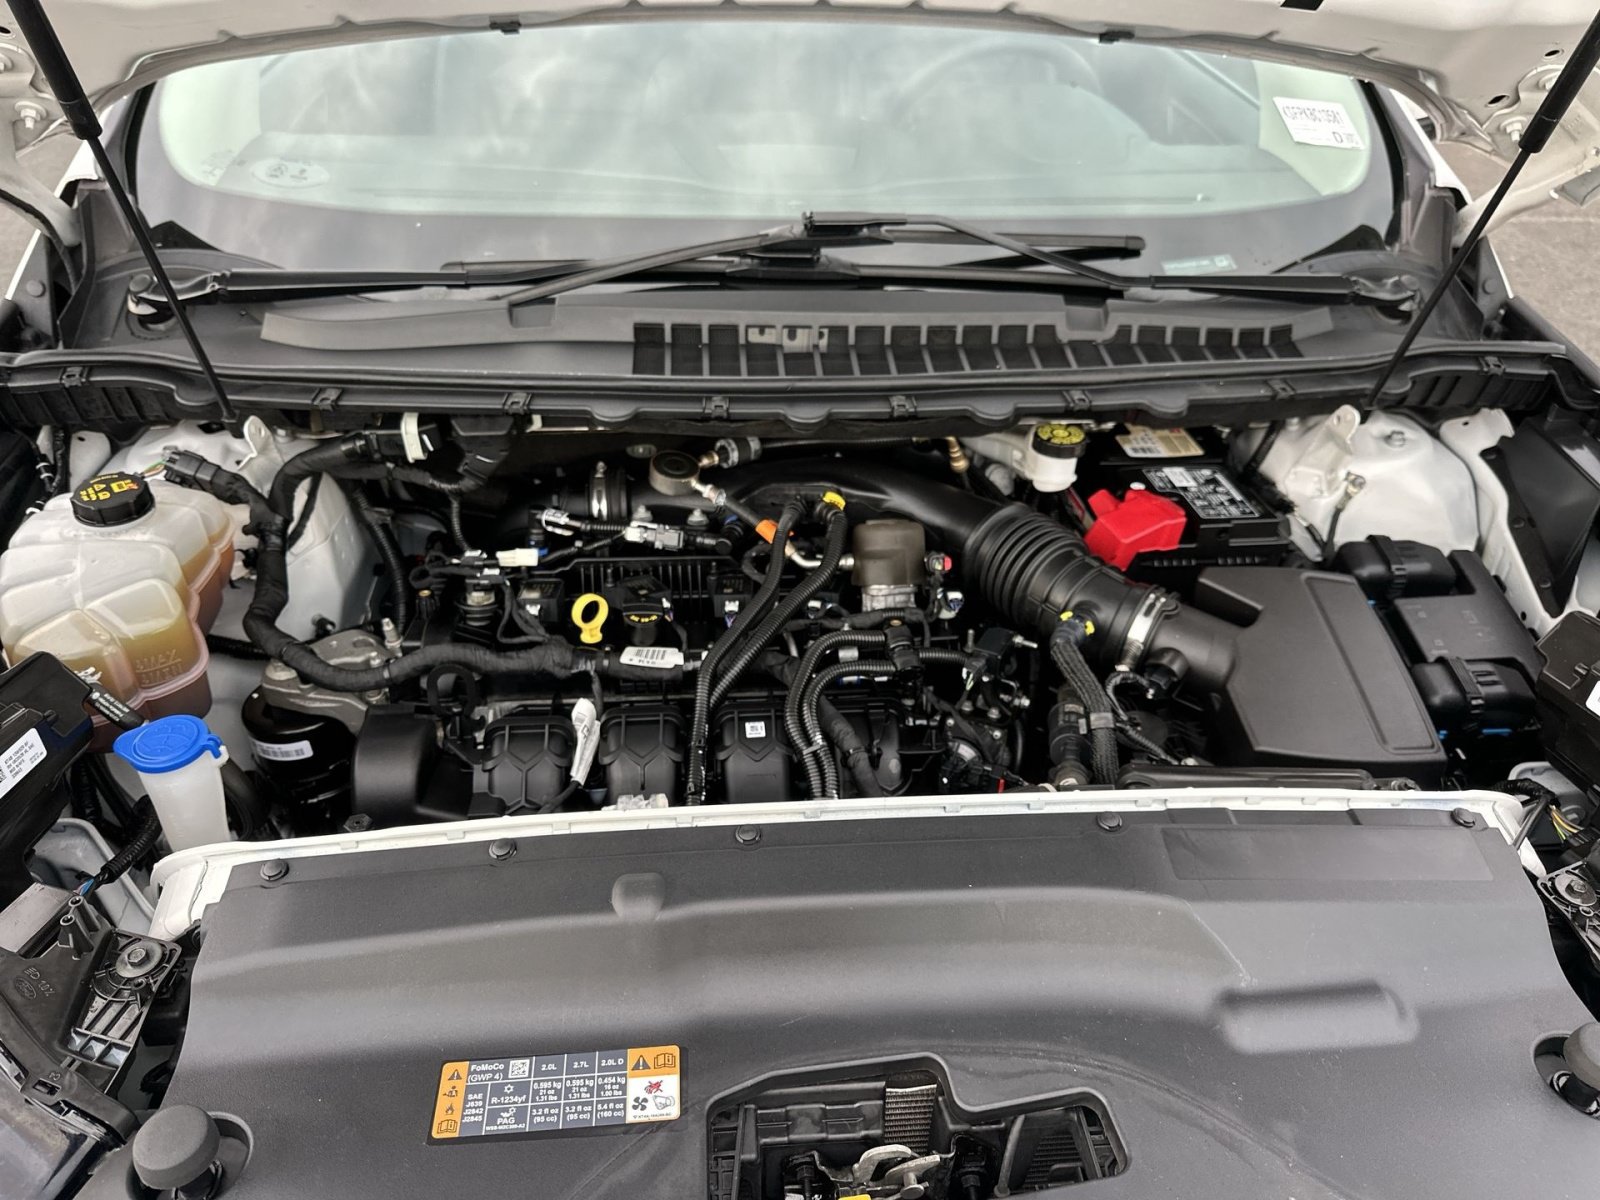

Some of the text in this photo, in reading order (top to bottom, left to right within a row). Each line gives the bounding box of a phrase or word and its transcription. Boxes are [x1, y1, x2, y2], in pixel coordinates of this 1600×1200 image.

[1332, 131, 1344, 144] D
[471, 1063, 505, 1072] FoMoCo
[467, 1073, 503, 1083] (GWP 4)
[617, 1076, 626, 1084] kg
[552, 1081, 561, 1090] kg
[585, 1079, 594, 1087] kg
[491, 1095, 527, 1104] R-1234yf
[533, 1115, 558, 1124] (95 cc)
[579, 1112, 590, 1120] cc)
[497, 1117, 516, 1125] PAG
